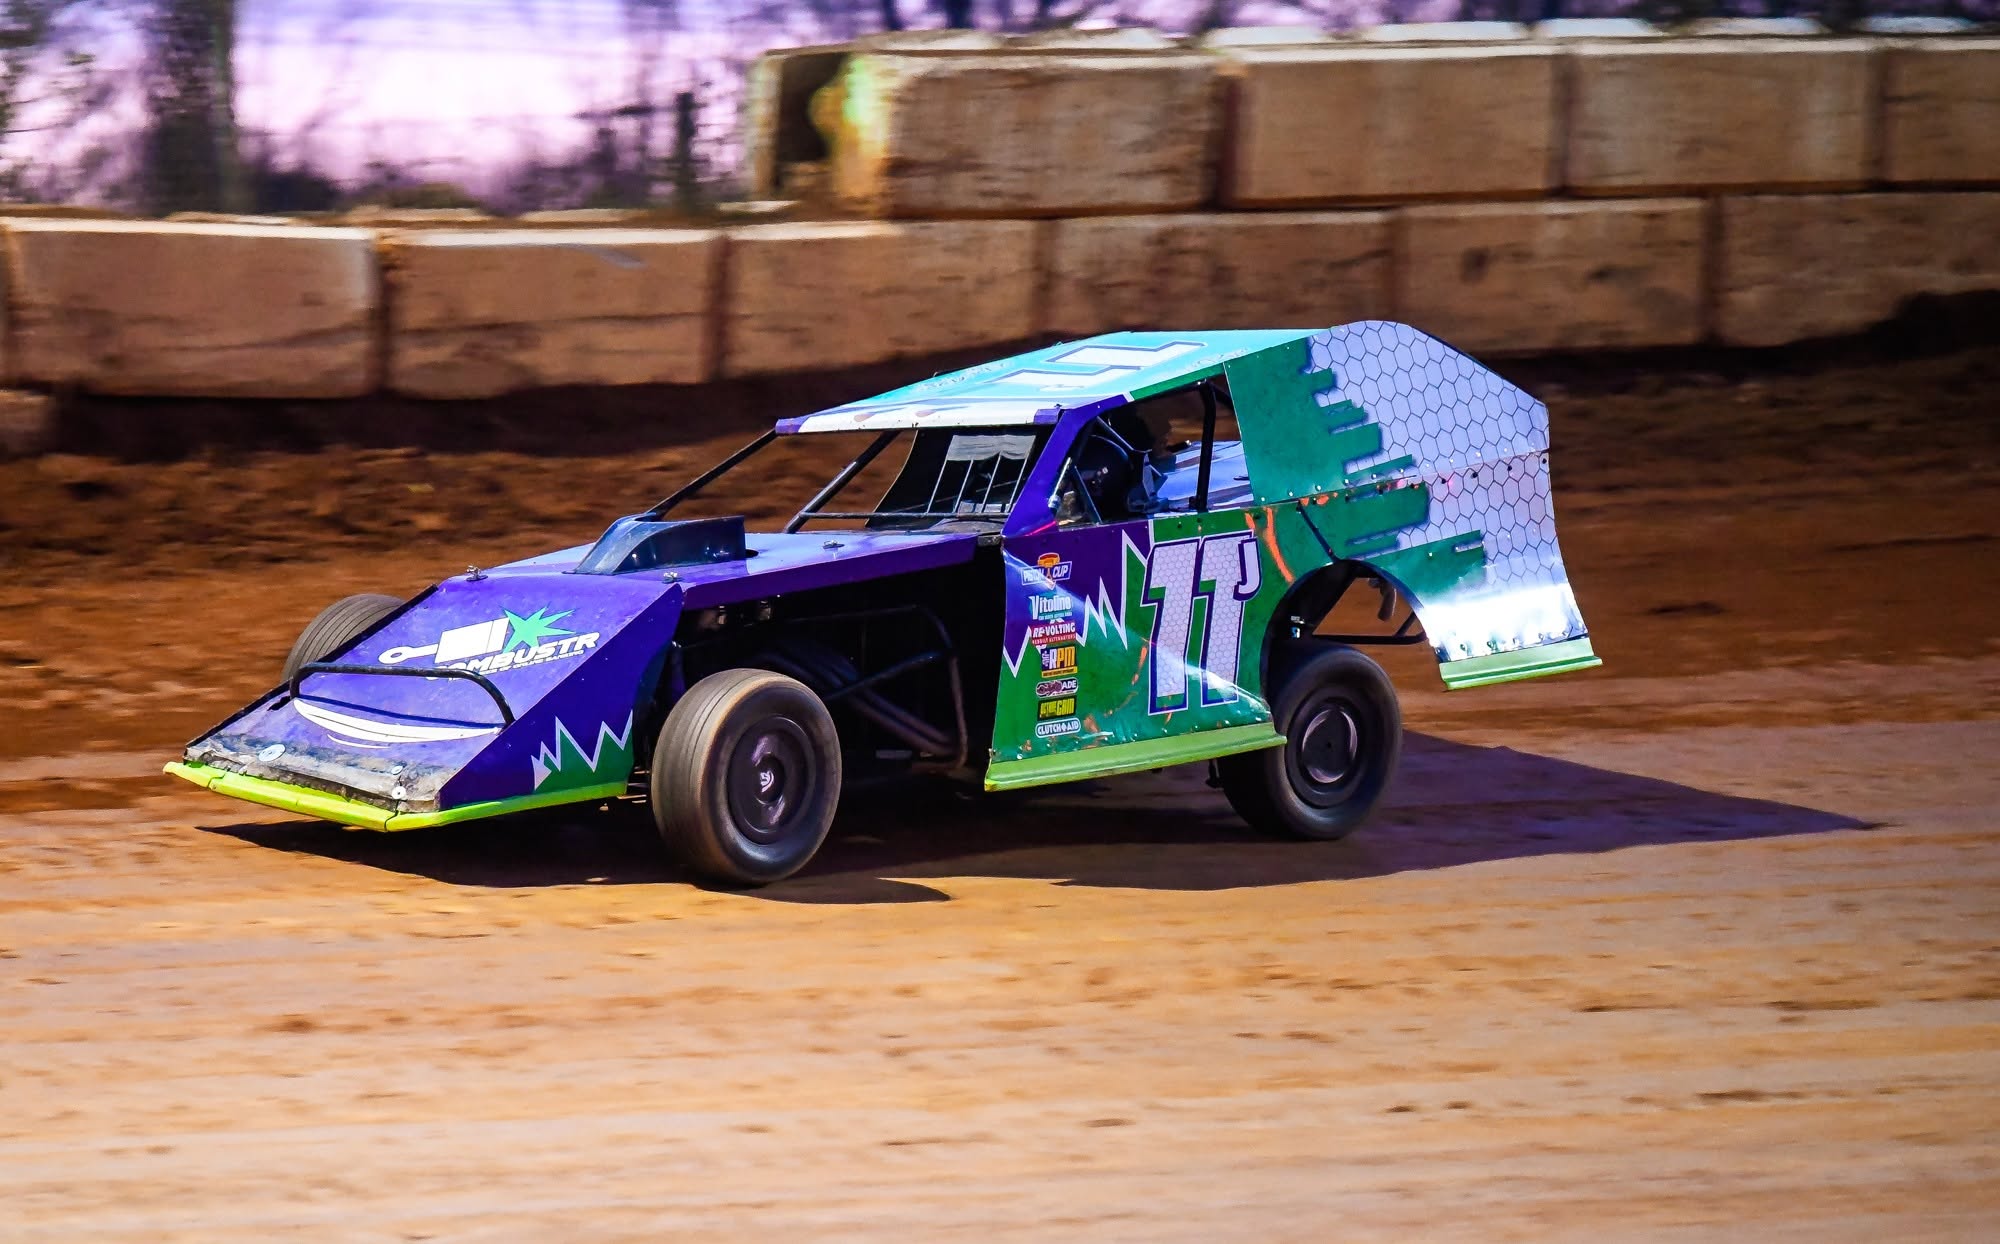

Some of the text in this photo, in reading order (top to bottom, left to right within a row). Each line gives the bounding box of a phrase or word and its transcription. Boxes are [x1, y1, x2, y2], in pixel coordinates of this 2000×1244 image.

[1053, 564, 1069, 579] CUP
[426, 631, 600, 680] OMBUSTR
[1049, 646, 1075, 670] RPM
[1038, 723, 1061, 735] CLUTCH
